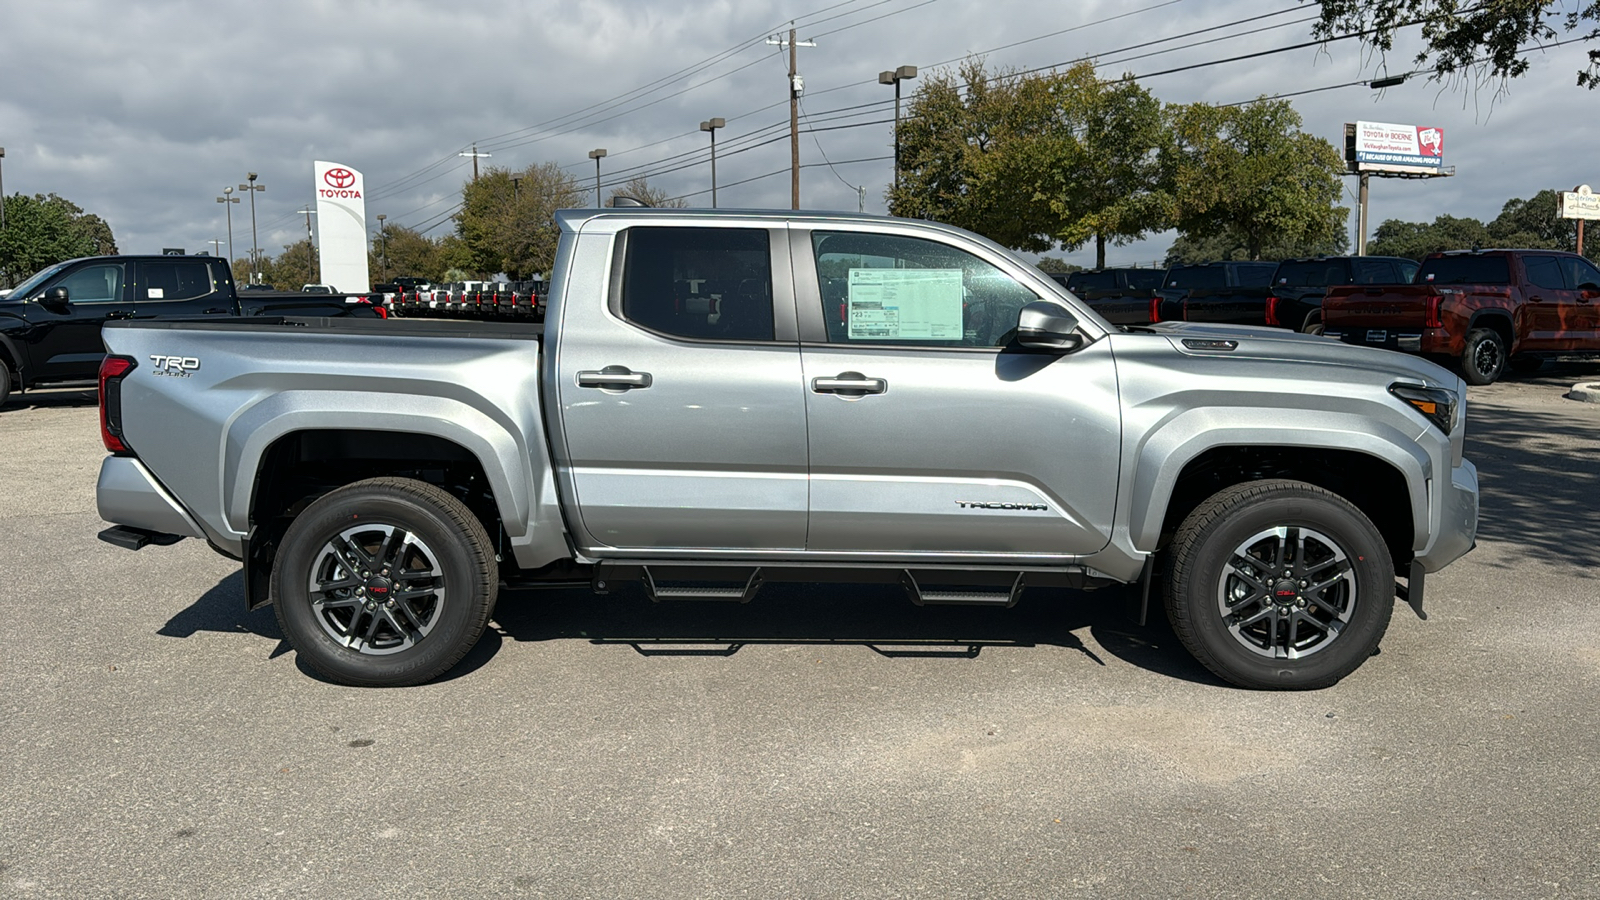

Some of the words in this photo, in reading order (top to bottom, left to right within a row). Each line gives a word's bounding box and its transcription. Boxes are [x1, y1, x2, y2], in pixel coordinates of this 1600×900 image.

[1363, 130, 1384, 138] TOYOTA
[1391, 133, 1412, 141] BOERNE
[1366, 153, 1385, 161] BECAUSE
[319, 189, 361, 199] TOYOTA
[150, 354, 201, 371] TRD
[152, 370, 194, 378] SPORT
[955, 500, 1048, 511] TACOMA
[394, 623, 458, 675] GRABBER
